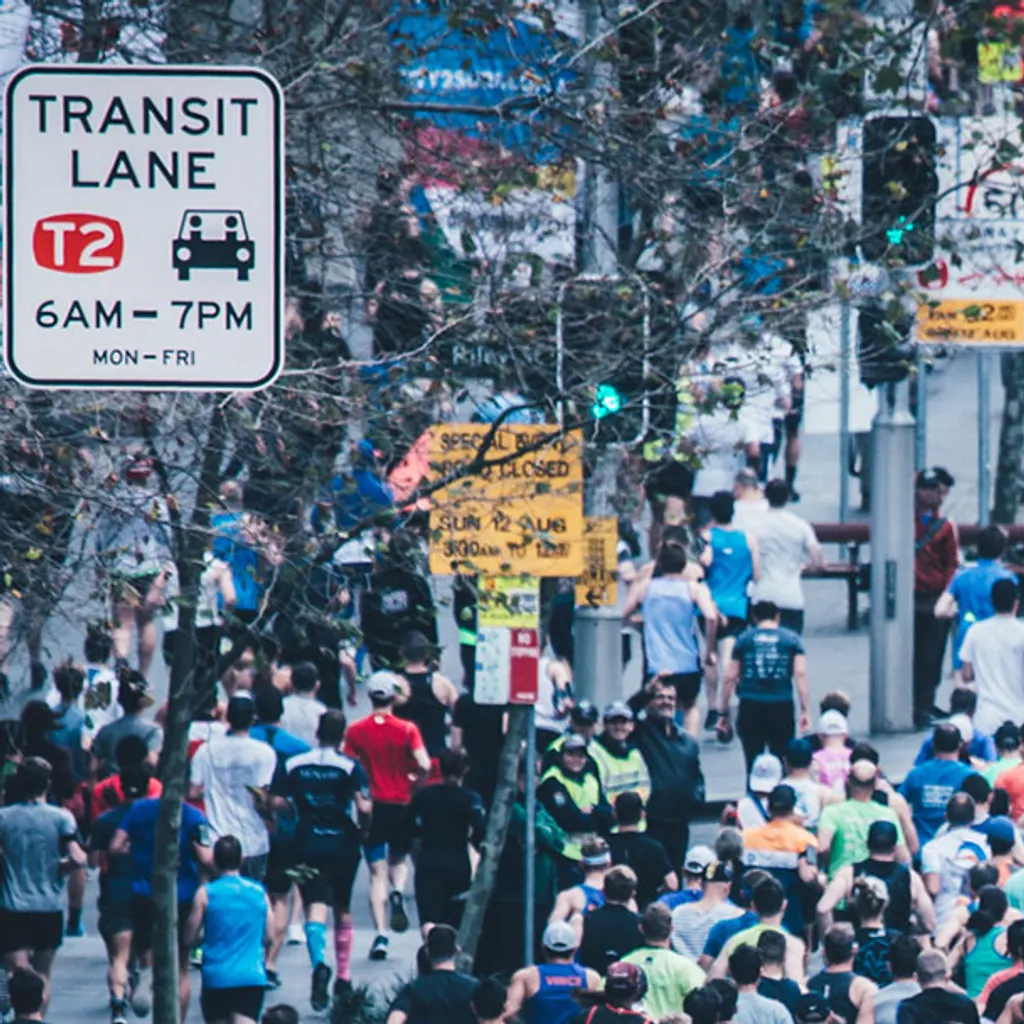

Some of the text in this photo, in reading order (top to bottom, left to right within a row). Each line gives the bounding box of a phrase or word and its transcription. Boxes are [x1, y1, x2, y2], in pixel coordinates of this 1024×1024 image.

[28, 94, 258, 136] TRANSIT
[71, 149, 216, 189] LANE
[42, 222, 115, 268] T2
[35, 300, 122, 329] 6AM
[171, 301, 252, 330] 7PM
[499, 460, 570, 479] CLOSED
[439, 516, 480, 532] SUN
